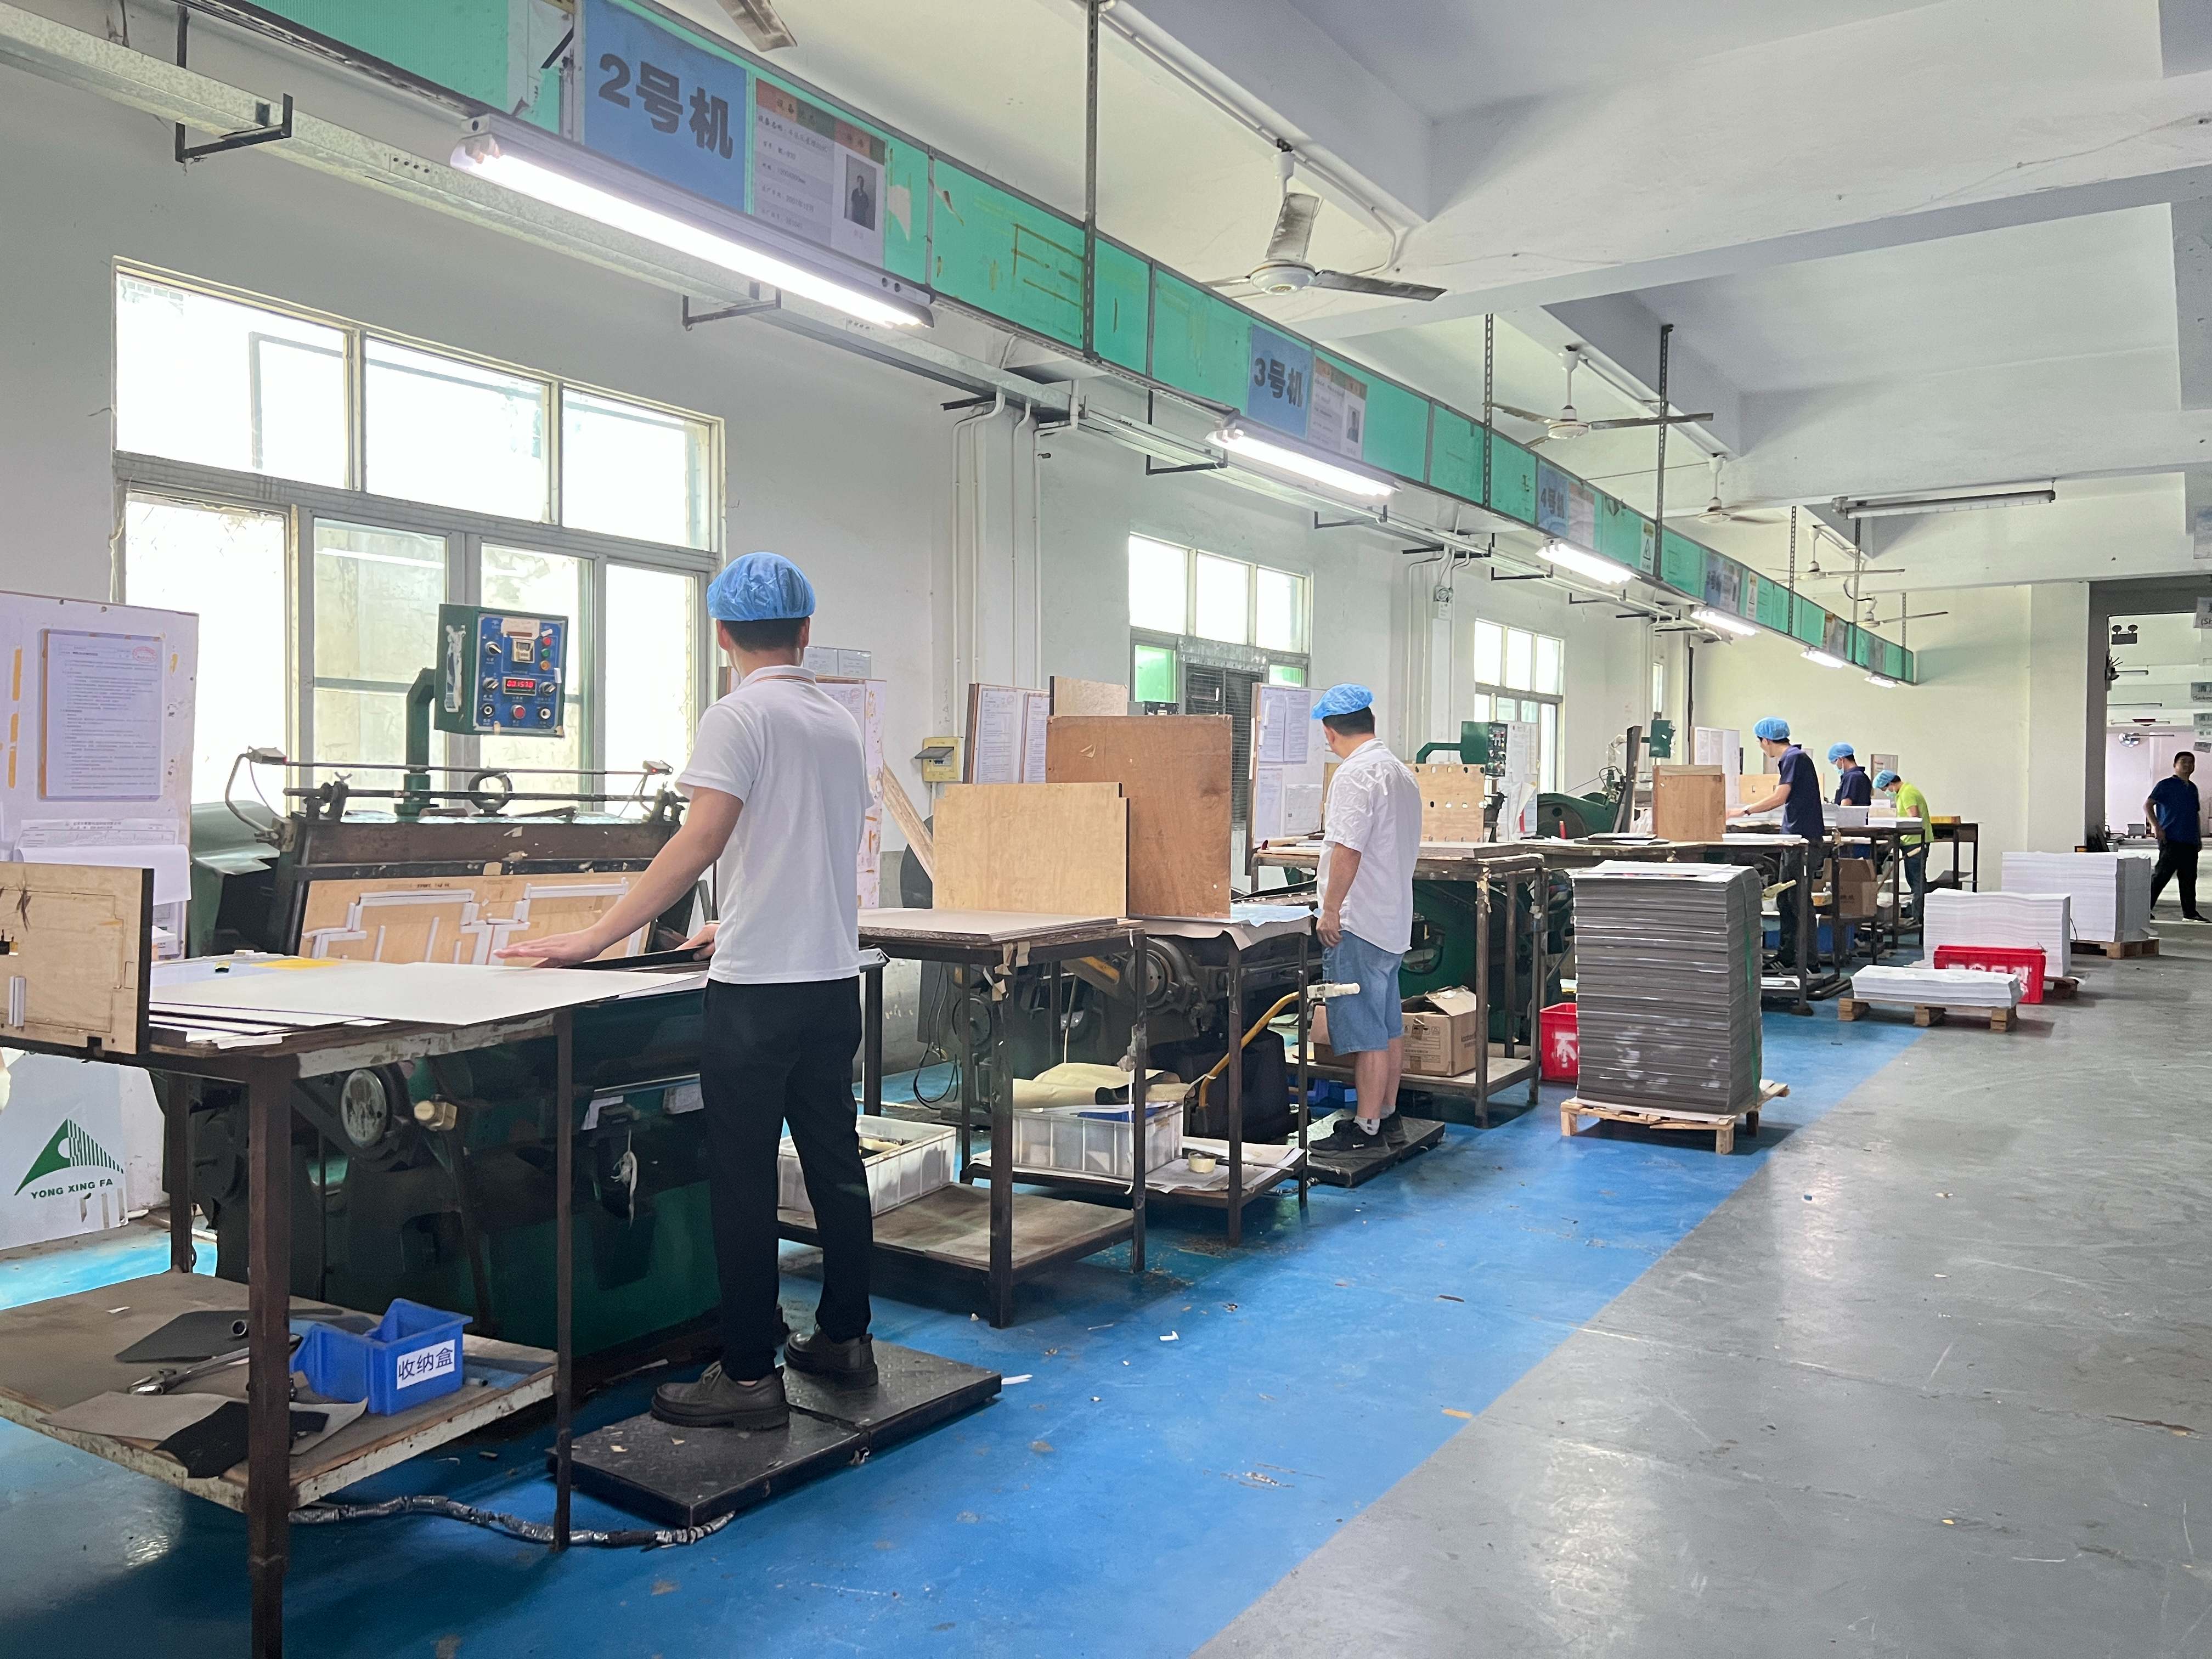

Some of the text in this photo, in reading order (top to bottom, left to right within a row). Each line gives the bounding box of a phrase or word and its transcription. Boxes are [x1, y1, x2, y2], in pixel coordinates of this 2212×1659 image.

[599, 53, 733, 159] 2号机
[1254, 358, 1303, 408] 3号机
[31, 1178, 114, 1200] YONG XING FA
[397, 1347, 453, 1383] 收纳盒
